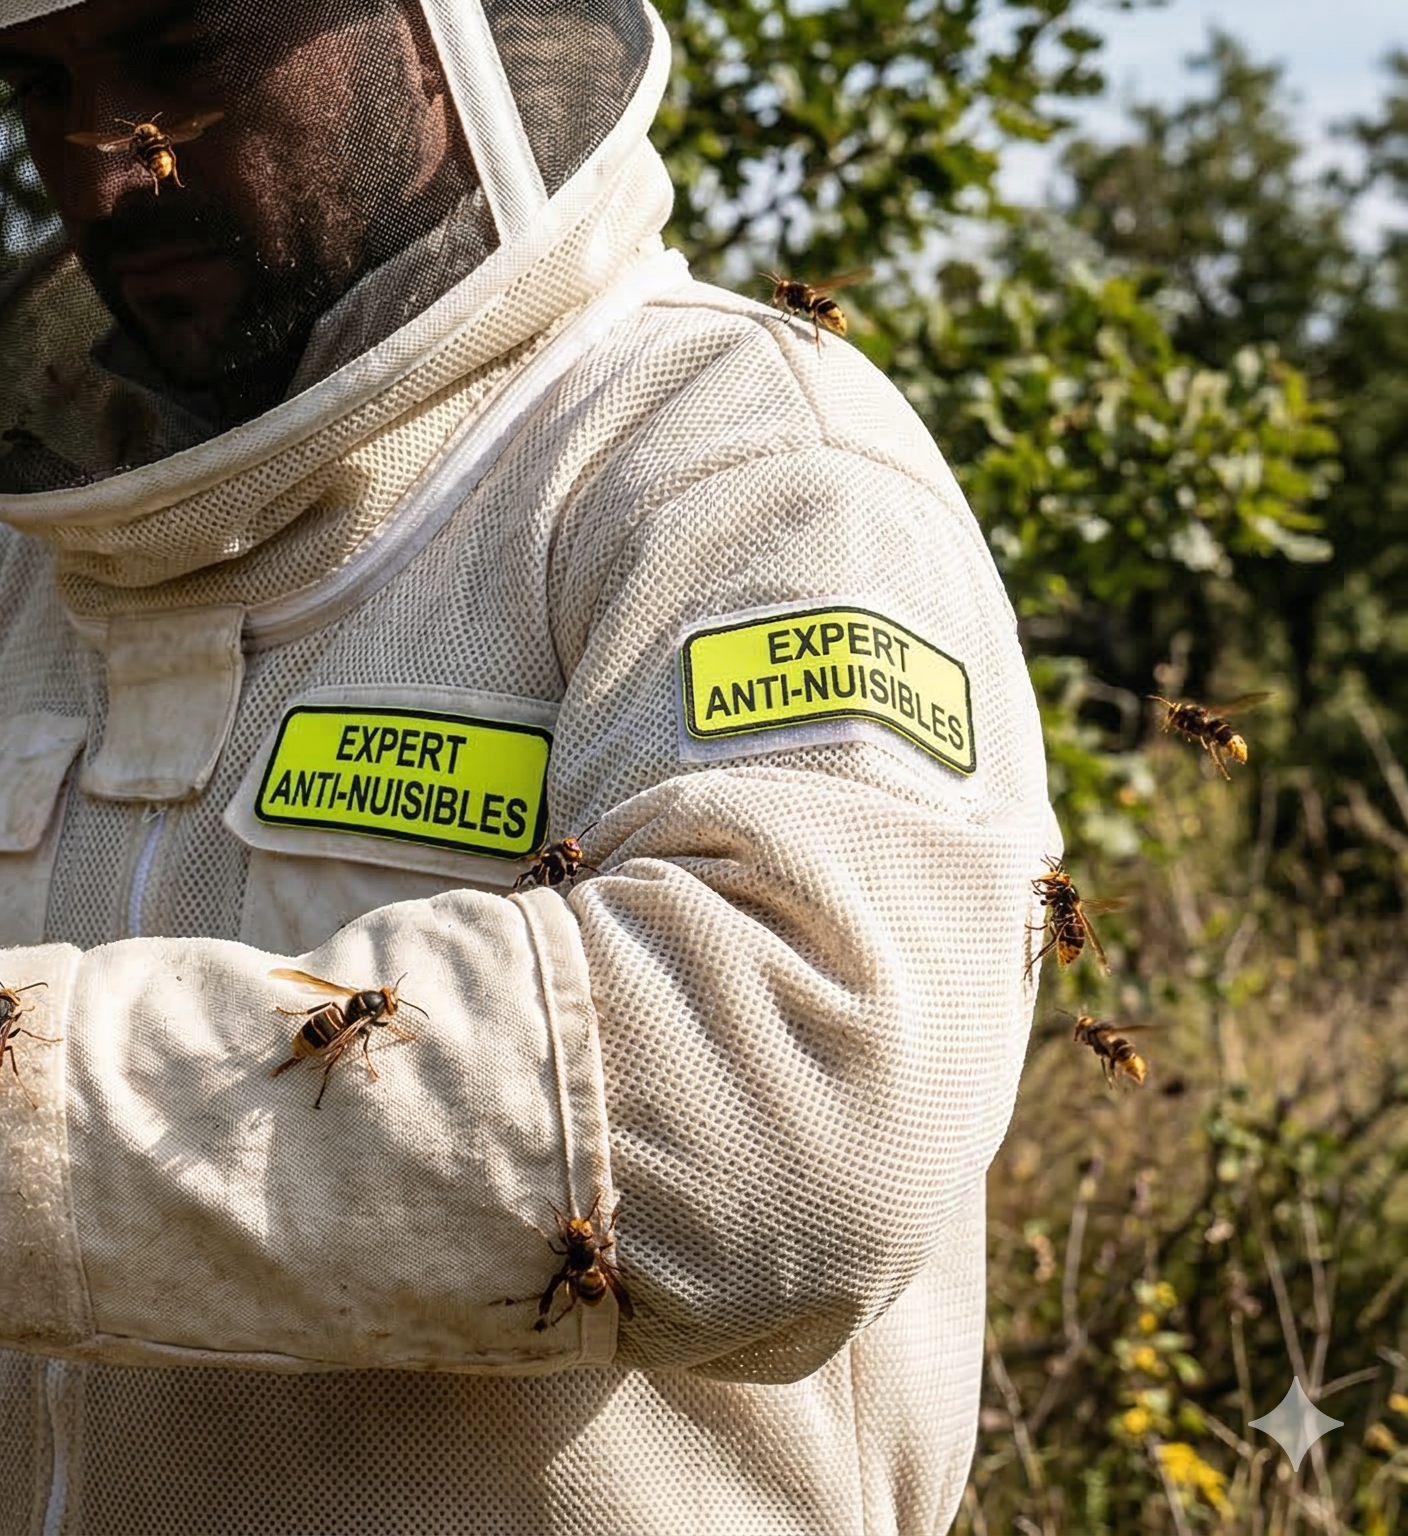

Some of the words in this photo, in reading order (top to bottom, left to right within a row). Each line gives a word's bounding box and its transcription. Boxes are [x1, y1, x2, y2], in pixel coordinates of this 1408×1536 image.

[767, 622, 911, 674] EXPERT
[704, 664, 965, 752] ANTI-NUISIBLES
[336, 725, 467, 776] EXPERT
[268, 770, 528, 839] ANTI-NUISIBLES
